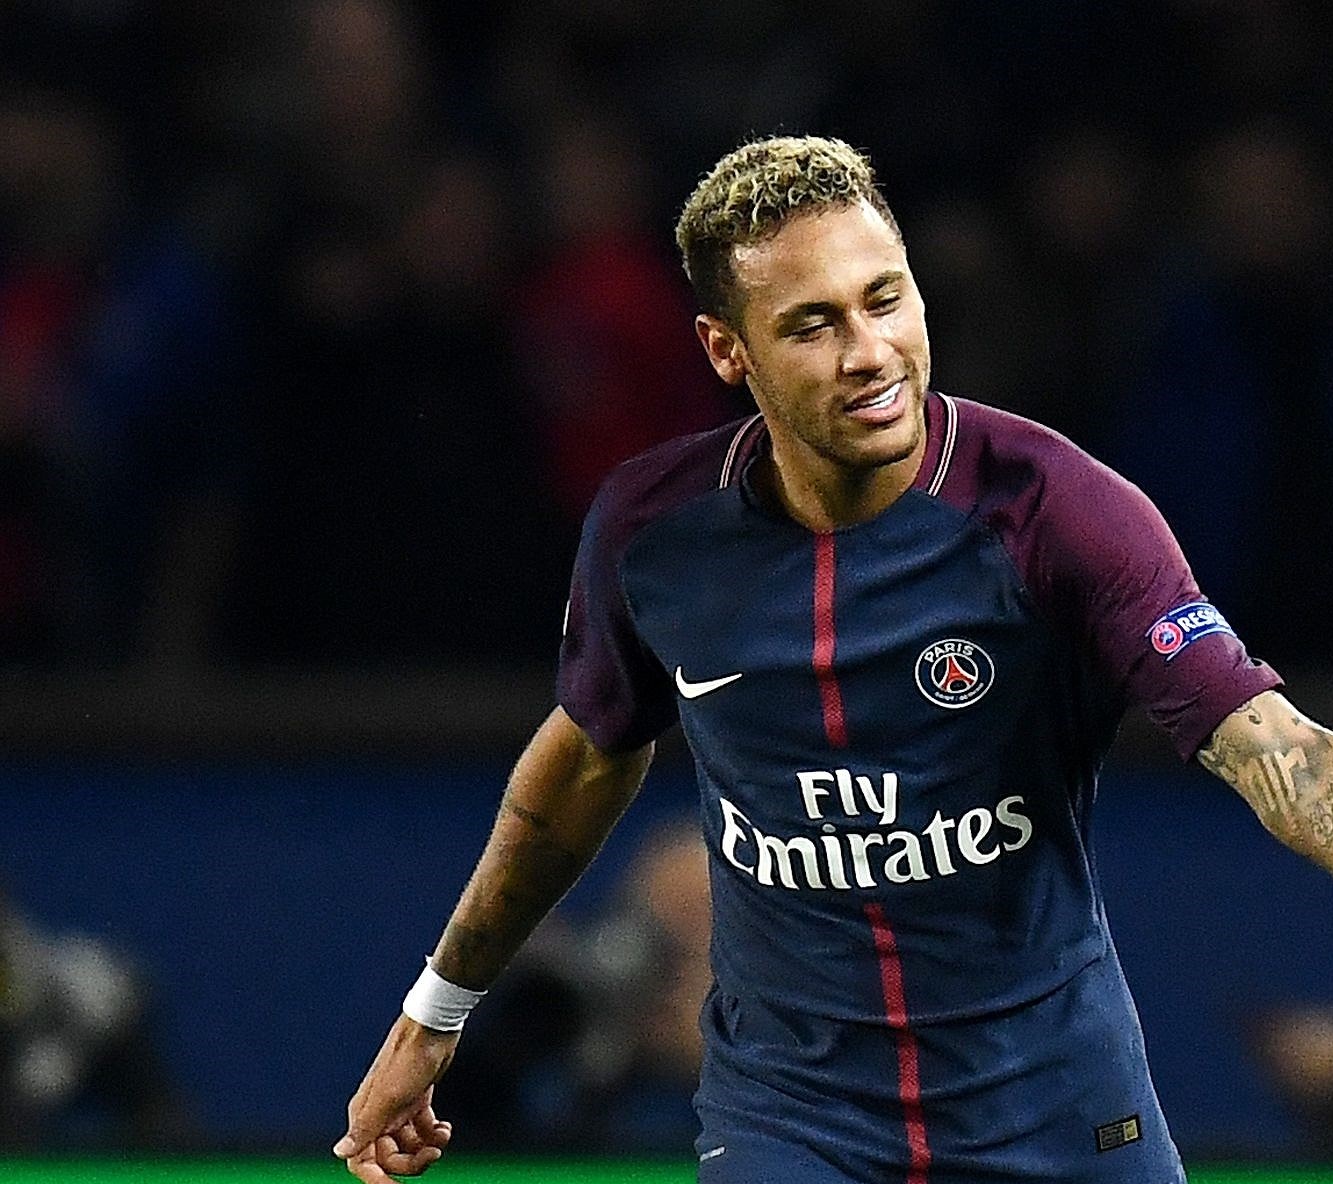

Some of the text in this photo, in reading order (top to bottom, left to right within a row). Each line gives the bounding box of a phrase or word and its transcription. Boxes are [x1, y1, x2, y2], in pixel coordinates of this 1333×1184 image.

[924, 643, 975, 663] PARIS
[796, 768, 899, 826] Fly
[719, 795, 1034, 892] Emirates
